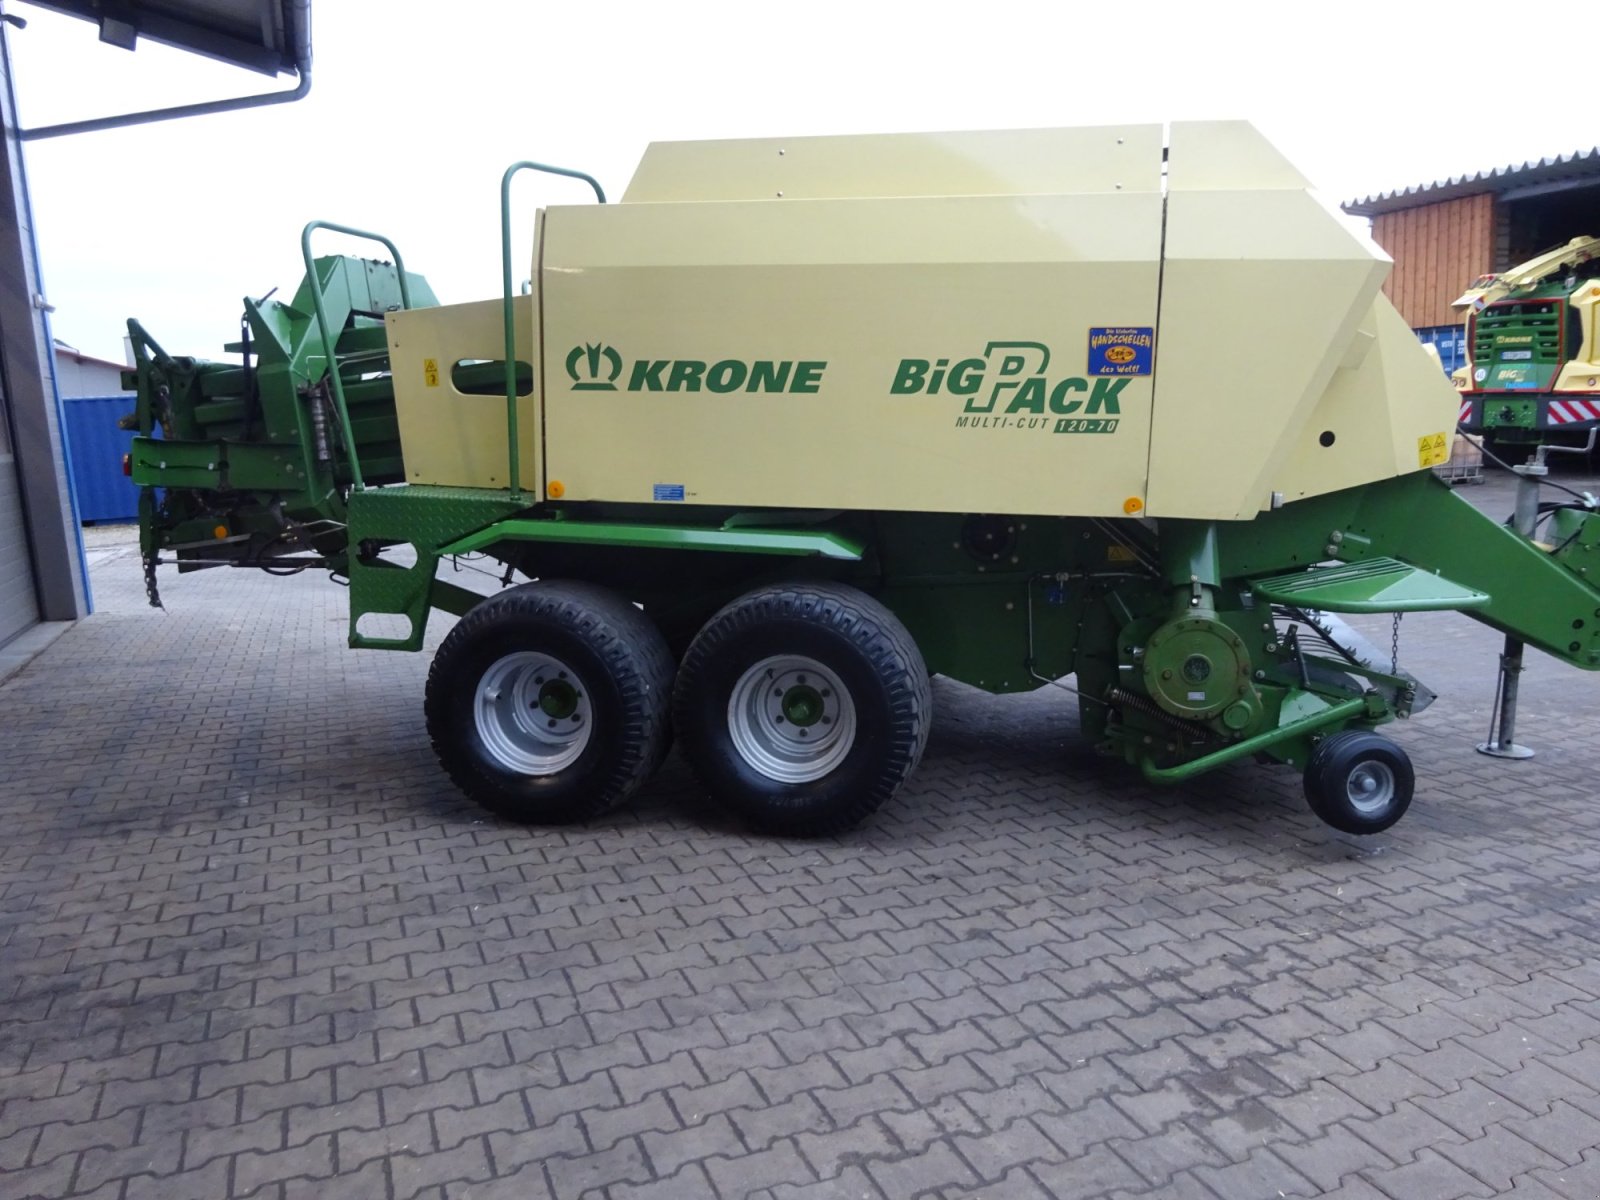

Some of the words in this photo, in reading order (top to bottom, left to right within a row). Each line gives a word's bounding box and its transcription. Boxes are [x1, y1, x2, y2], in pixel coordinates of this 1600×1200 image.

[1091, 335, 1151, 349] HANDSCHELLEN
[627, 359, 828, 393] KRONE
[955, 417, 1050, 429] MULTI-CUT
[1057, 420, 1116, 432] 120-70
